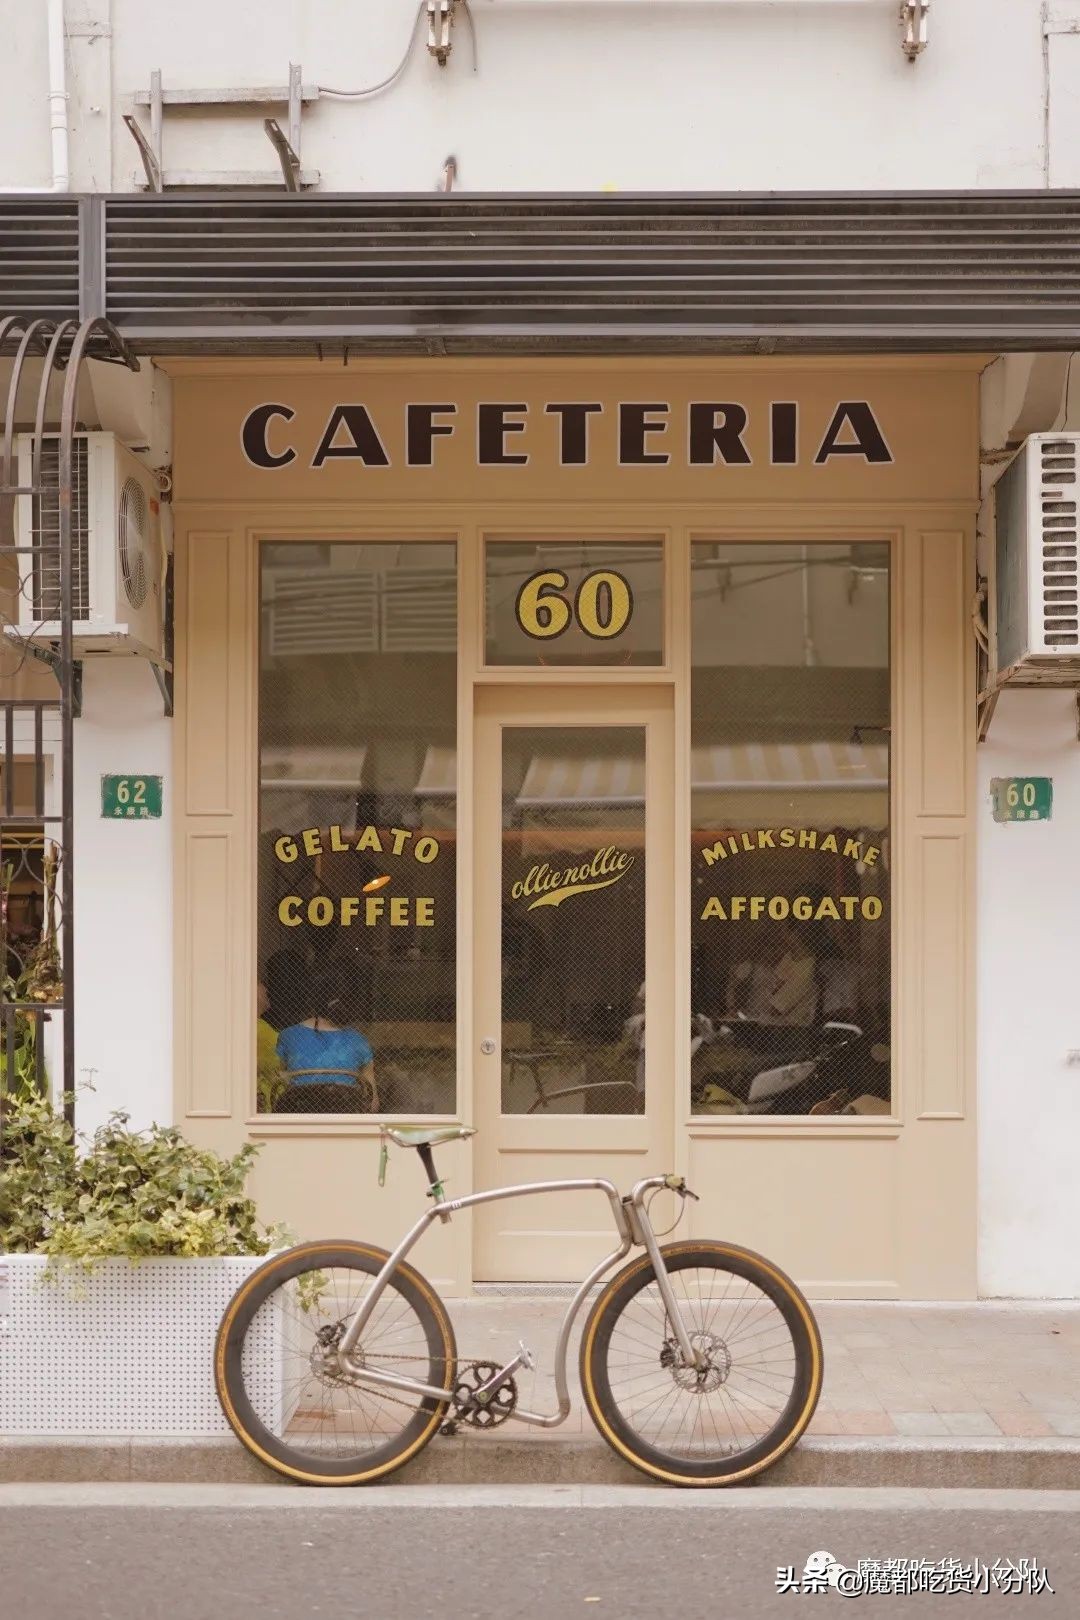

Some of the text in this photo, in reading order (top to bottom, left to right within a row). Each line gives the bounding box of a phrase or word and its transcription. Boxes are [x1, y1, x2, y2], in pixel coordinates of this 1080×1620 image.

[240, 401, 895, 468] CAFETERIA
[515, 568, 633, 640] 60
[117, 780, 146, 803] 62
[1006, 783, 1036, 807] 60
[274, 825, 440, 864] GELATO
[701, 828, 881, 867] MILKSHAKE
[278, 896, 436, 927] COFFEE
[700, 896, 884, 921] AFFOGATO
